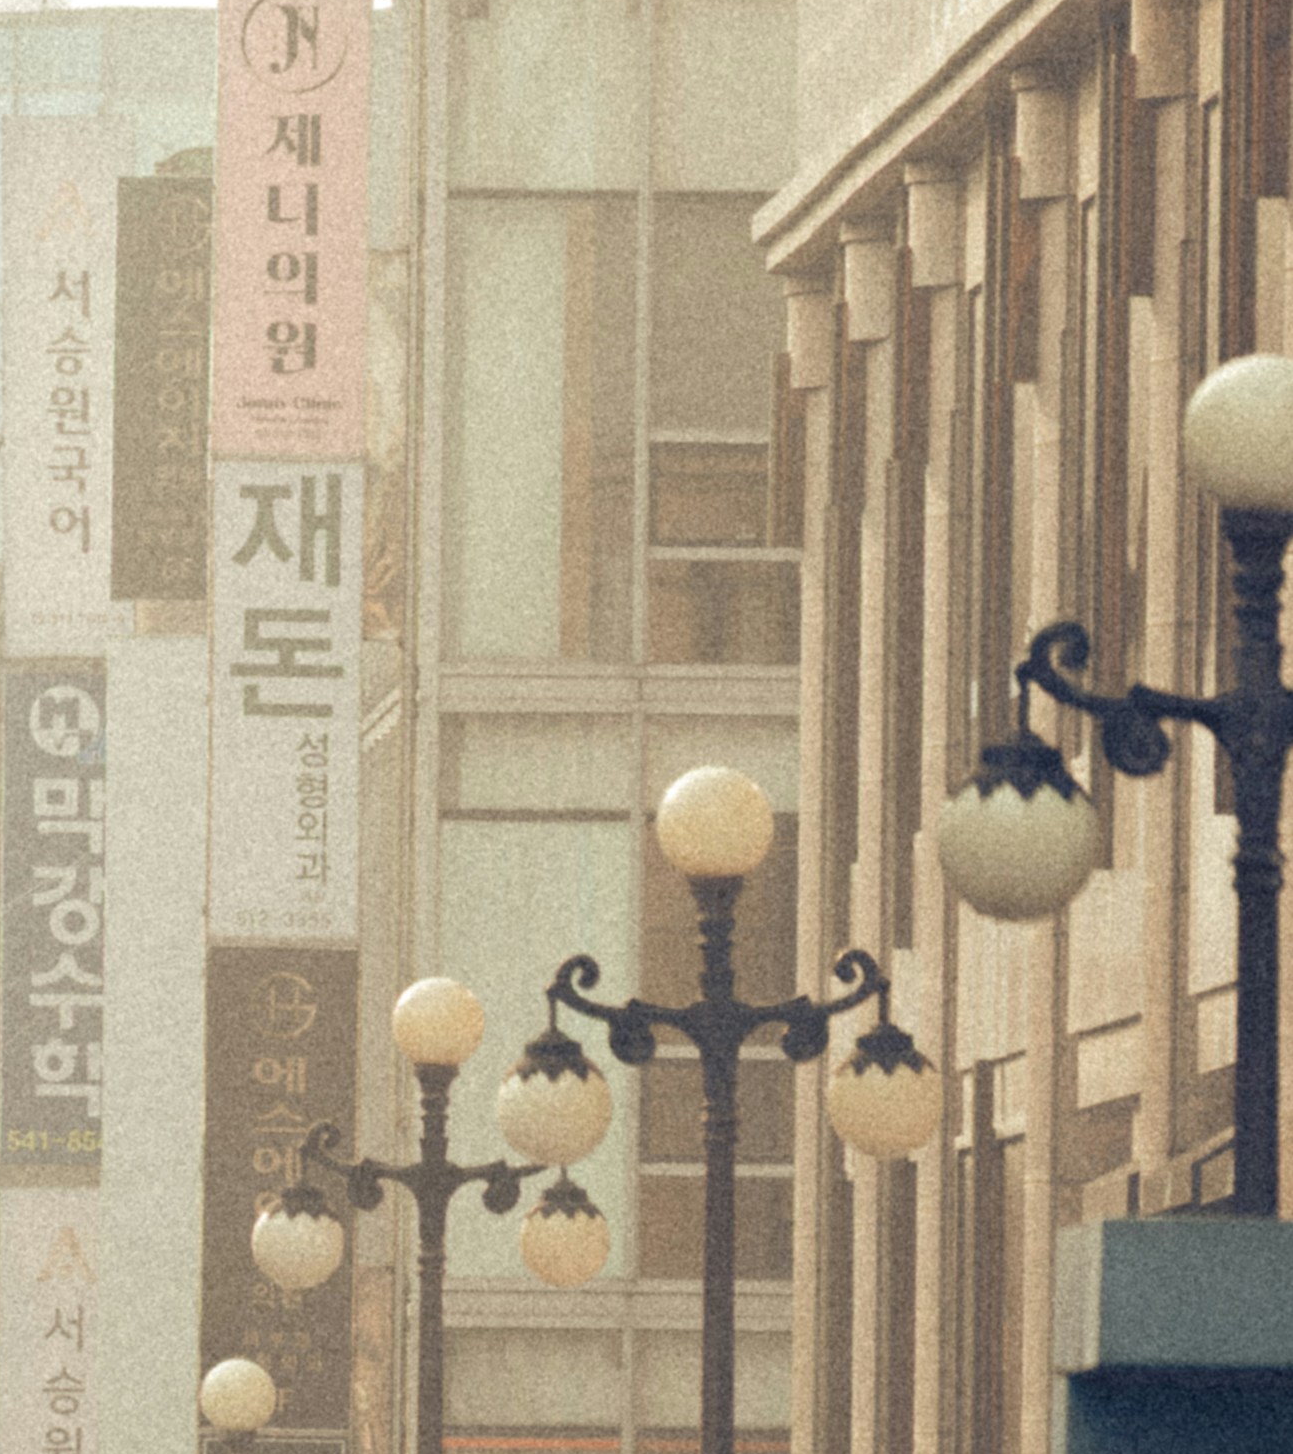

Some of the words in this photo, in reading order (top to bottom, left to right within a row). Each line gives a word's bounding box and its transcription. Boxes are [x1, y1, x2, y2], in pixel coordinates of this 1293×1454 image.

[264, 113, 321, 375] 제니의원
[47, 269, 92, 553] 서승원국어
[229, 472, 345, 719] 재돈
[295, 732, 333, 885] 성형외과
[28, 776, 105, 1119] 막강수학
[7, 1129, 104, 1153] 541-85
